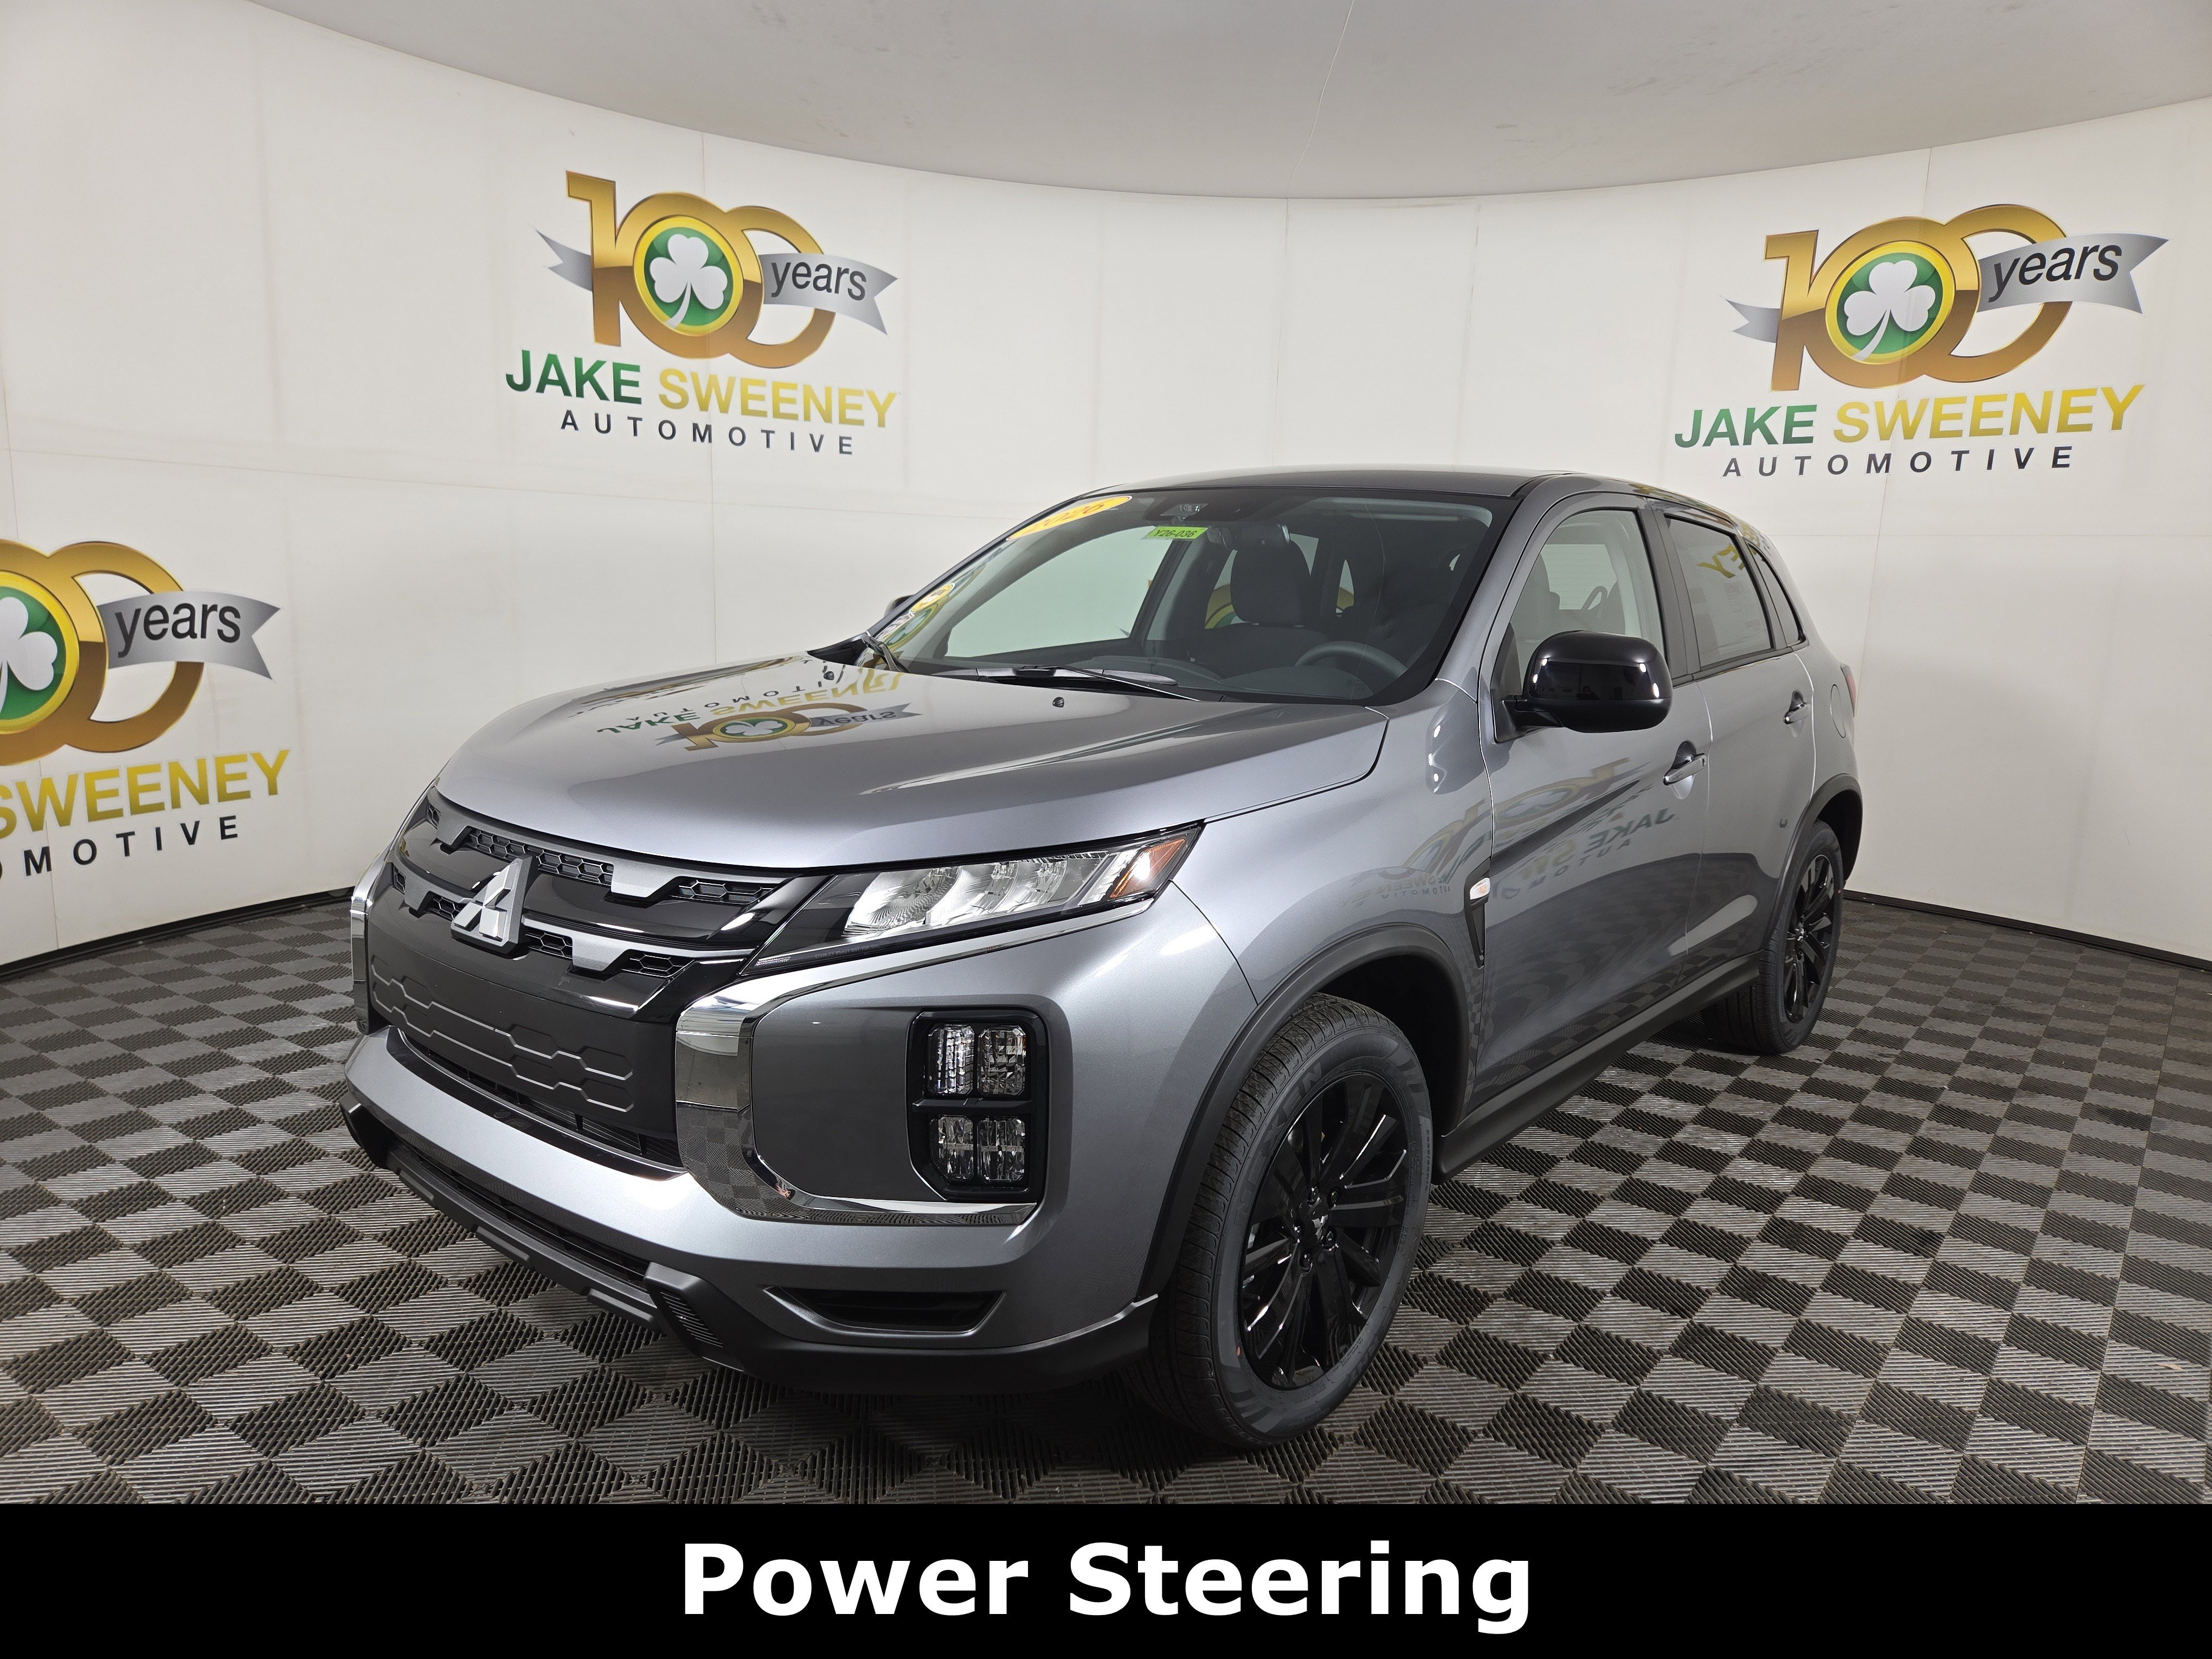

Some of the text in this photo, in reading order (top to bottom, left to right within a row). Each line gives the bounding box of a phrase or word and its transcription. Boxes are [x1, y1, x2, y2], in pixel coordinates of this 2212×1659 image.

[565, 171, 867, 368] 100 years
[1765, 204, 2121, 391] 100 years
[505, 349, 897, 428] JAKE SWEENEY
[1675, 384, 2145, 449] JAKE SWEENEY
[561, 409, 853, 455] AUTOMOTIVE
[1722, 446, 2072, 477] AUTOMOTIVE
[1153, 530, 1198, 538] Y26-036
[114, 602, 241, 658] years
[0, 815, 238, 879] MOTIVE
